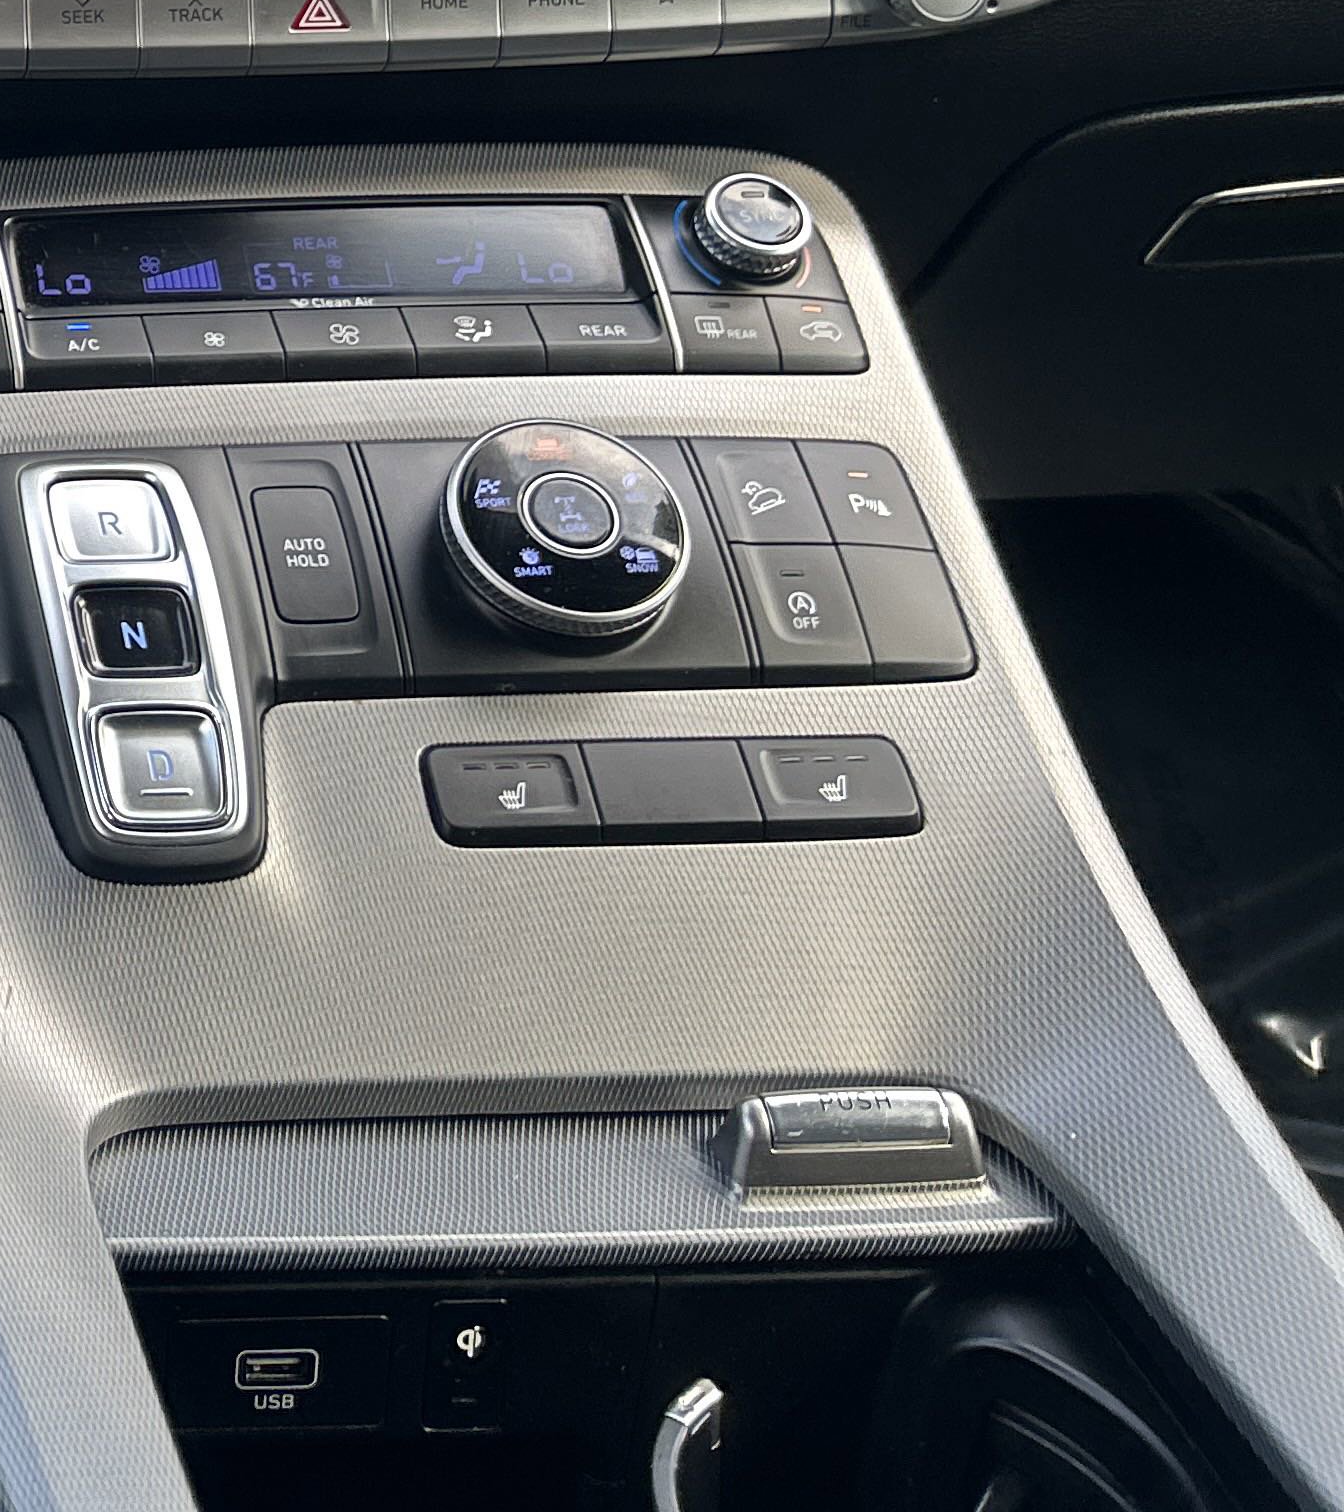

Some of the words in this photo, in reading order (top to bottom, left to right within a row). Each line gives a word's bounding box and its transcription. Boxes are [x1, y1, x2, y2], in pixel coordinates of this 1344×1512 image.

[61, 8, 105, 25] SEEK
[168, 6, 224, 24] TRACK
[840, 14, 872, 29] FILE
[293, 237, 337, 251] REAR
[517, 251, 575, 285] Lo
[35, 262, 93, 297] Lo
[312, 297, 351, 308] Clean
[355, 296, 374, 306] Air
[579, 324, 627, 339] REAR
[727, 328, 758, 343] REAR
[67, 337, 100, 354] A/C
[475, 495, 512, 509] SPORT
[98, 511, 121, 536] R
[283, 537, 325, 552] AUTO
[286, 553, 330, 569] HOLD
[625, 561, 660, 574] SNOW
[513, 564, 554, 578] SMART
[792, 615, 821, 631] OFF
[120, 620, 149, 650] N
[148, 750, 174, 781] D
[818, 1091, 892, 1114] PUSH
[253, 1392, 294, 1412] USB
